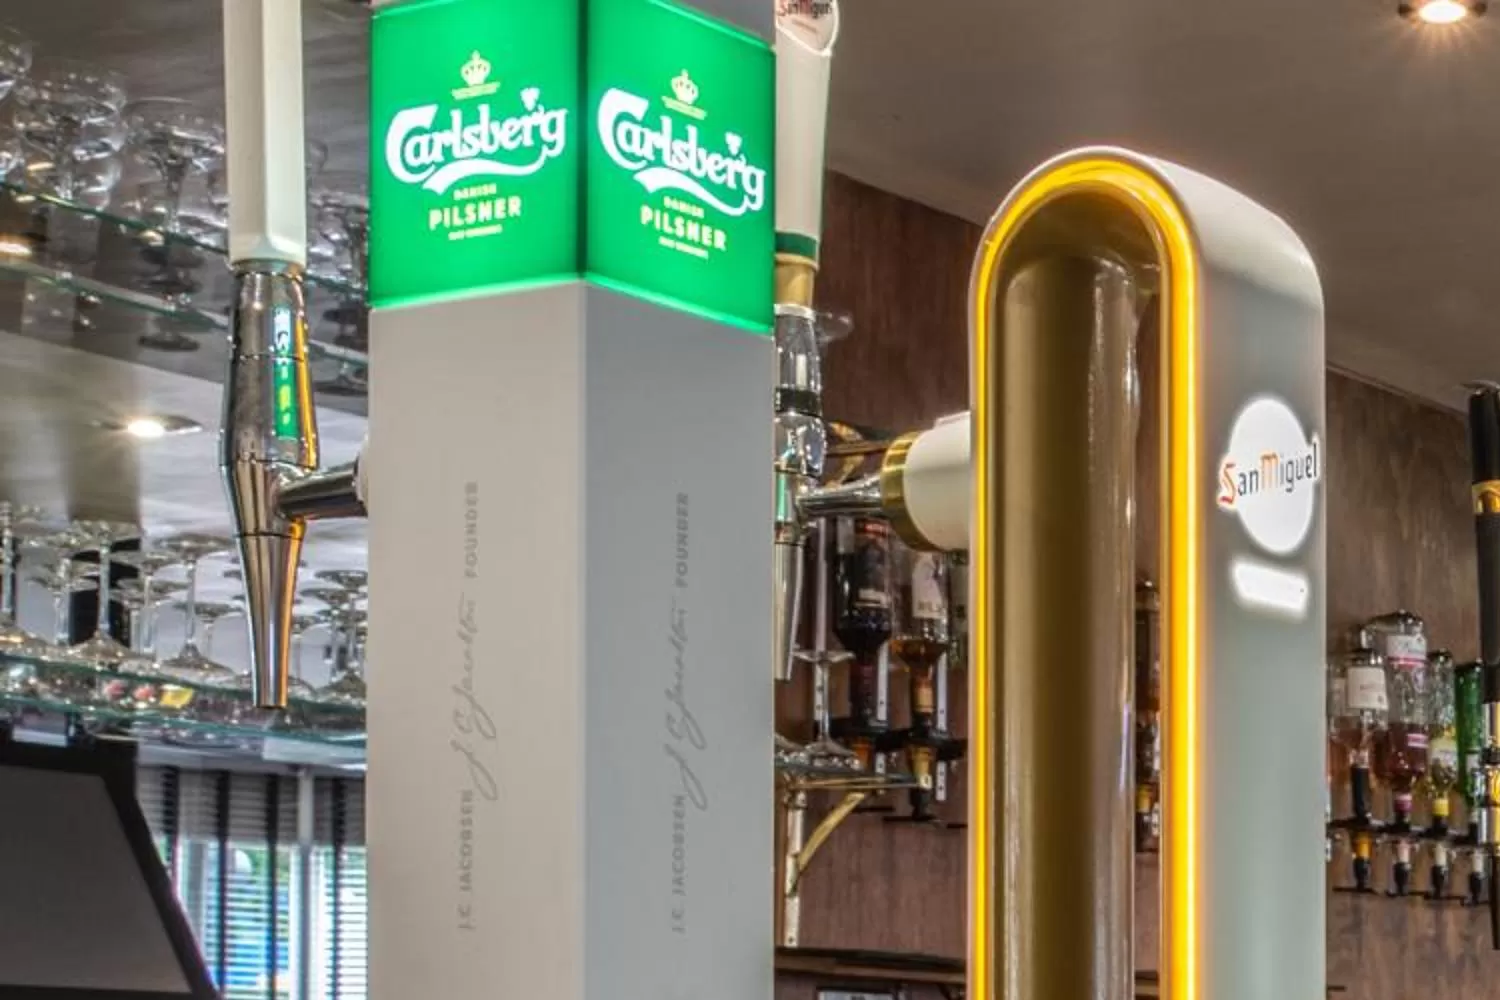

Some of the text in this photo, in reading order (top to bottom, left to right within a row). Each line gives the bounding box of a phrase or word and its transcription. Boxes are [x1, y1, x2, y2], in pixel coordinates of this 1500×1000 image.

[385, 90, 567, 194] Carlsberg
[597, 88, 766, 216] Carlsberg
[429, 195, 521, 230] PILSNER
[640, 204, 727, 251] PILSNER
[463, 481, 479, 579] FOUNDER
[675, 491, 689, 588] FOUNDER
[457, 789, 473, 892] JACOBSEN
[671, 794, 686, 896] JACOBSEN
